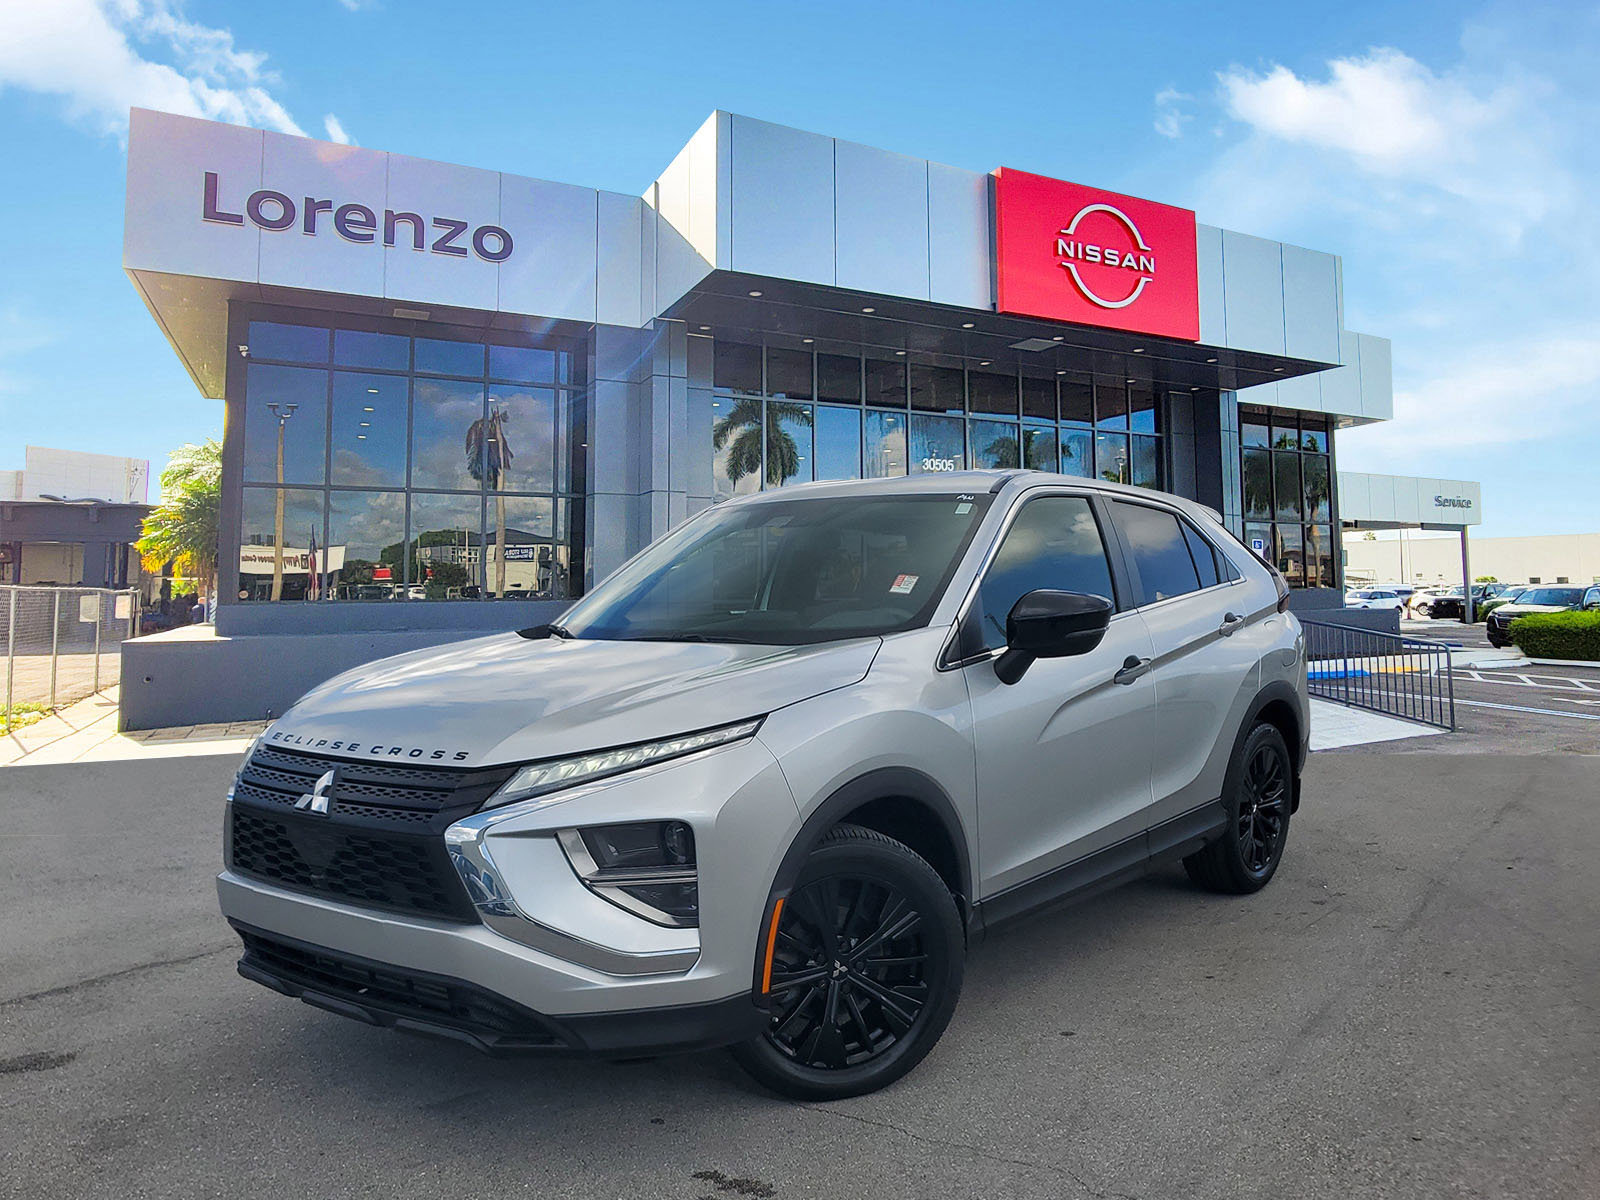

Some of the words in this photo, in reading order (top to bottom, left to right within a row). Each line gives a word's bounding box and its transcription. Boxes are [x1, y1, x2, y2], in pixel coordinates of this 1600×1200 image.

[203, 171, 514, 262] Lorenzo
[1057, 238, 1155, 273] NISSAN
[922, 457, 955, 472] 30505
[1434, 495, 1472, 509] Service
[272, 731, 361, 752] ECLIPSE
[370, 745, 470, 761] CROSS
